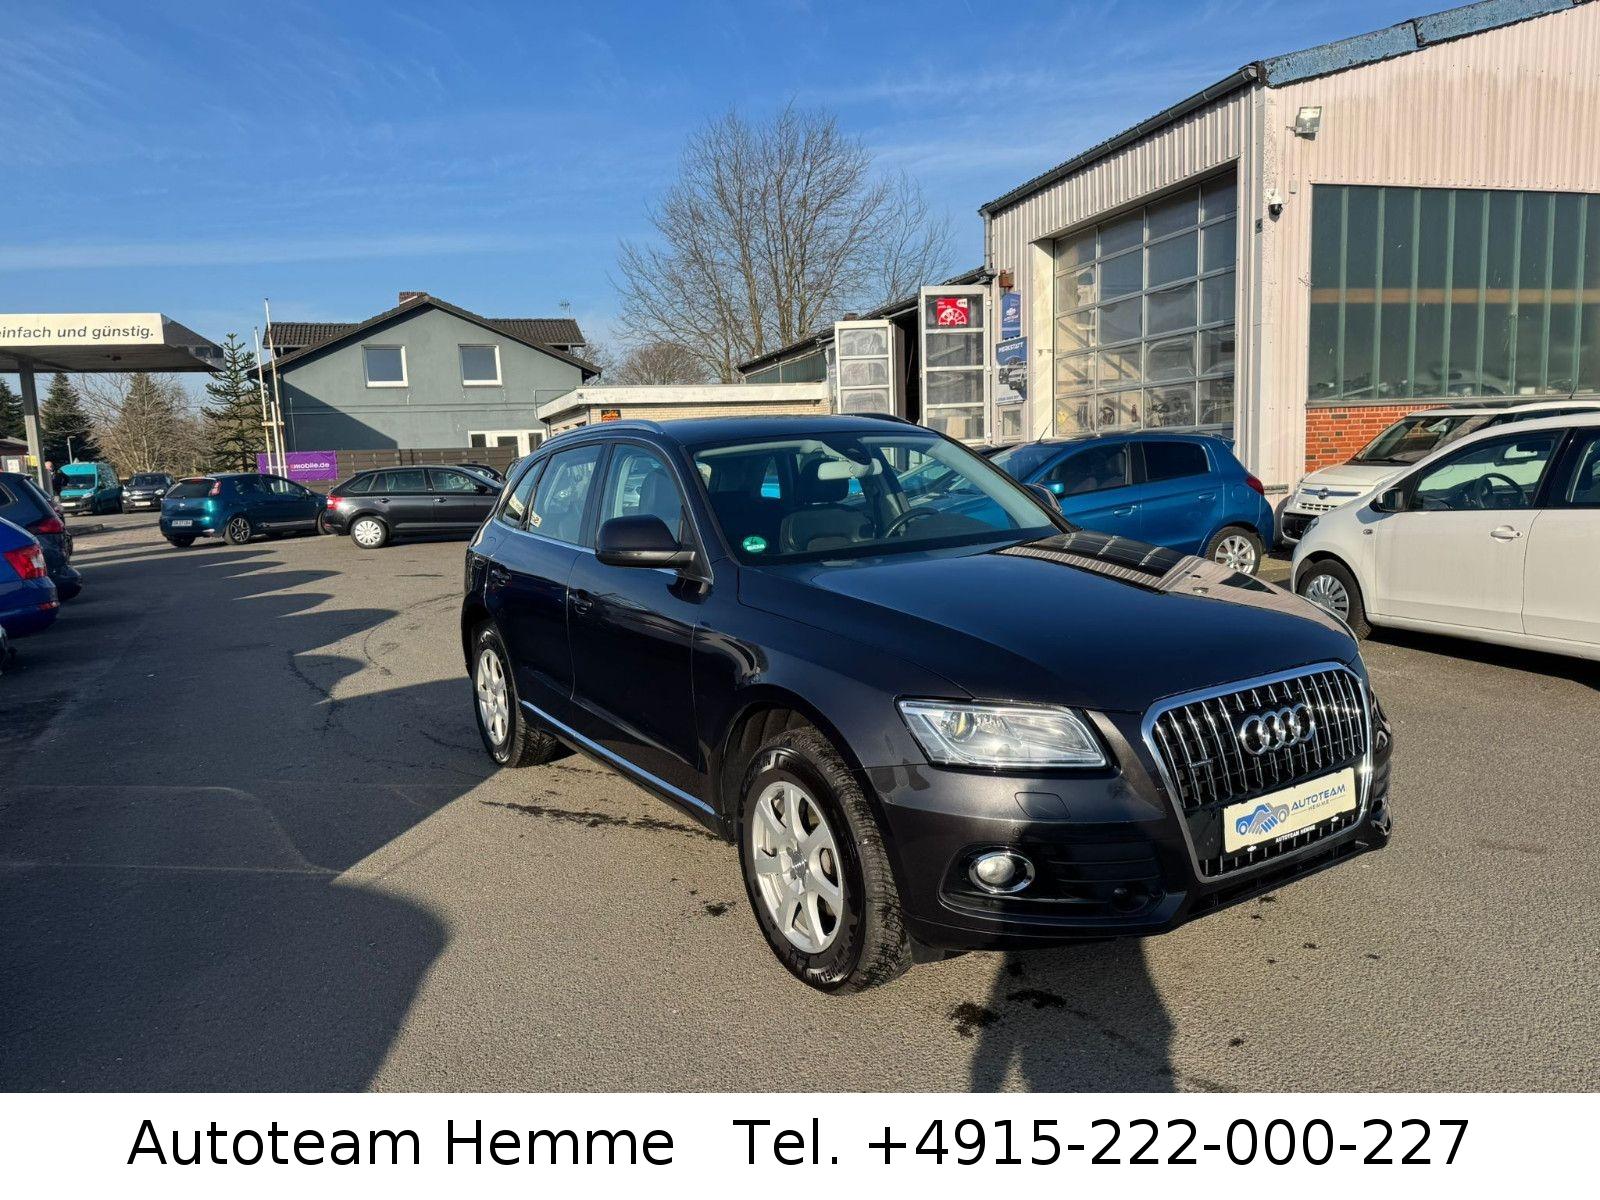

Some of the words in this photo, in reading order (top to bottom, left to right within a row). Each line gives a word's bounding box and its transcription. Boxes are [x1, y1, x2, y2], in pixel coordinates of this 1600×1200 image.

[0, 326, 51, 338] infach
[57, 326, 87, 338] und
[92, 325, 154, 340] günstig.
[1291, 784, 1345, 811] AUTOTEAM
[1275, 831, 1299, 843] AUTOTEAM
